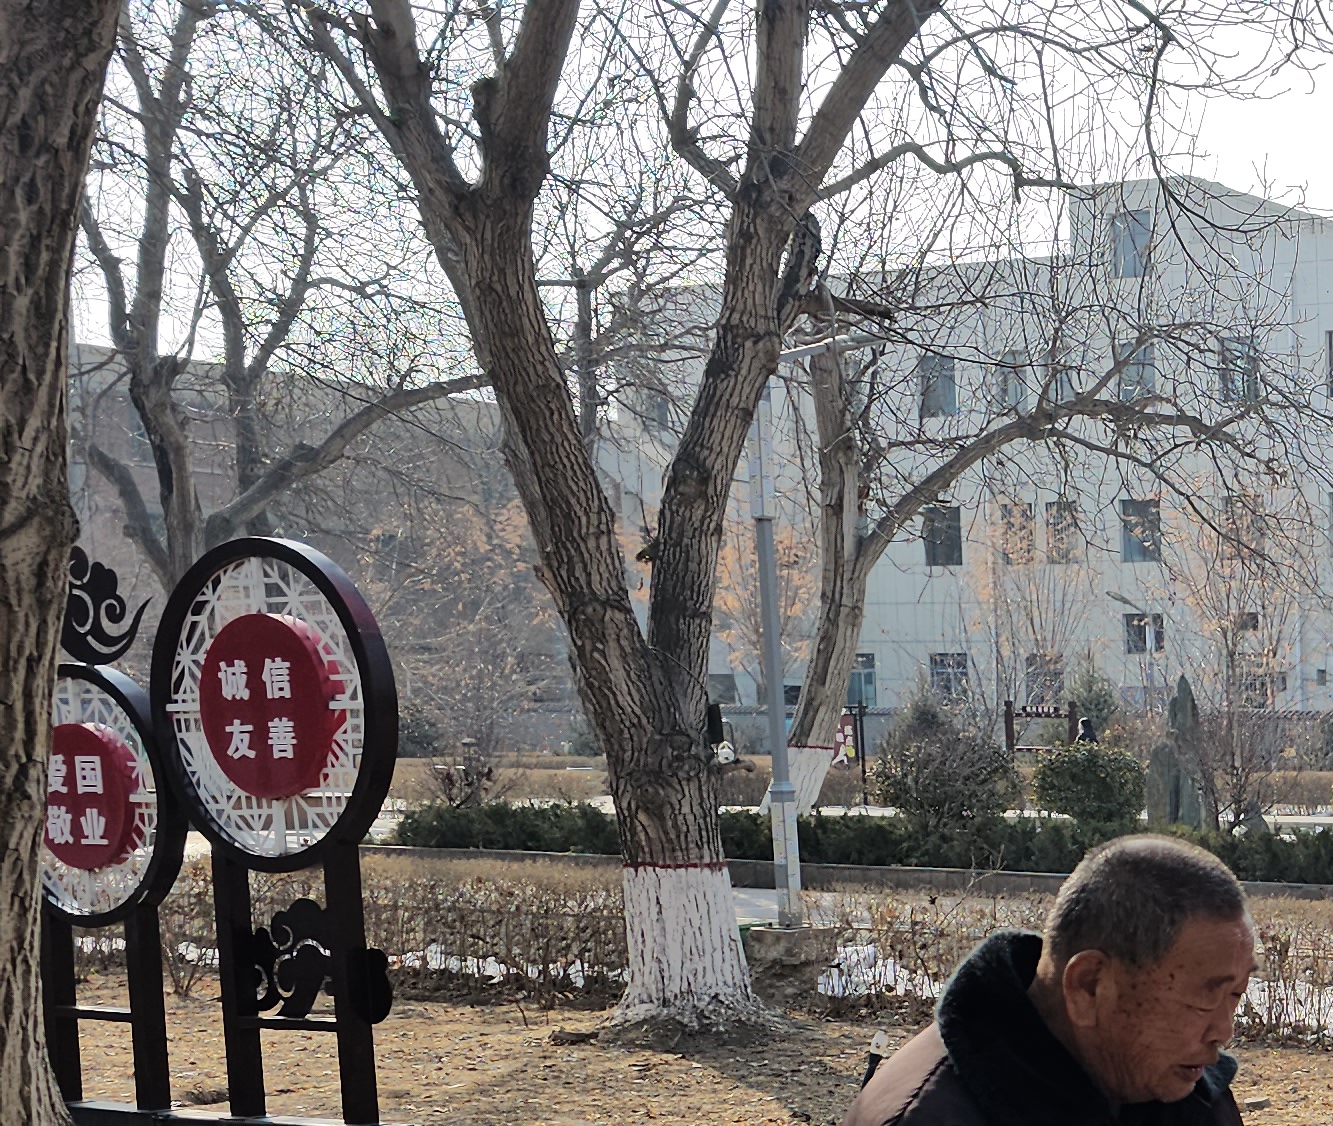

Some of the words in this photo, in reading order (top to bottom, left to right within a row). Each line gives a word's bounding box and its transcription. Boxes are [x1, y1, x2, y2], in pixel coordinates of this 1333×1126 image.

[218, 657, 292, 700] 诚信
[225, 717, 298, 760] 友善
[48, 754, 104, 794] 爱国
[46, 805, 109, 845] 敬业
